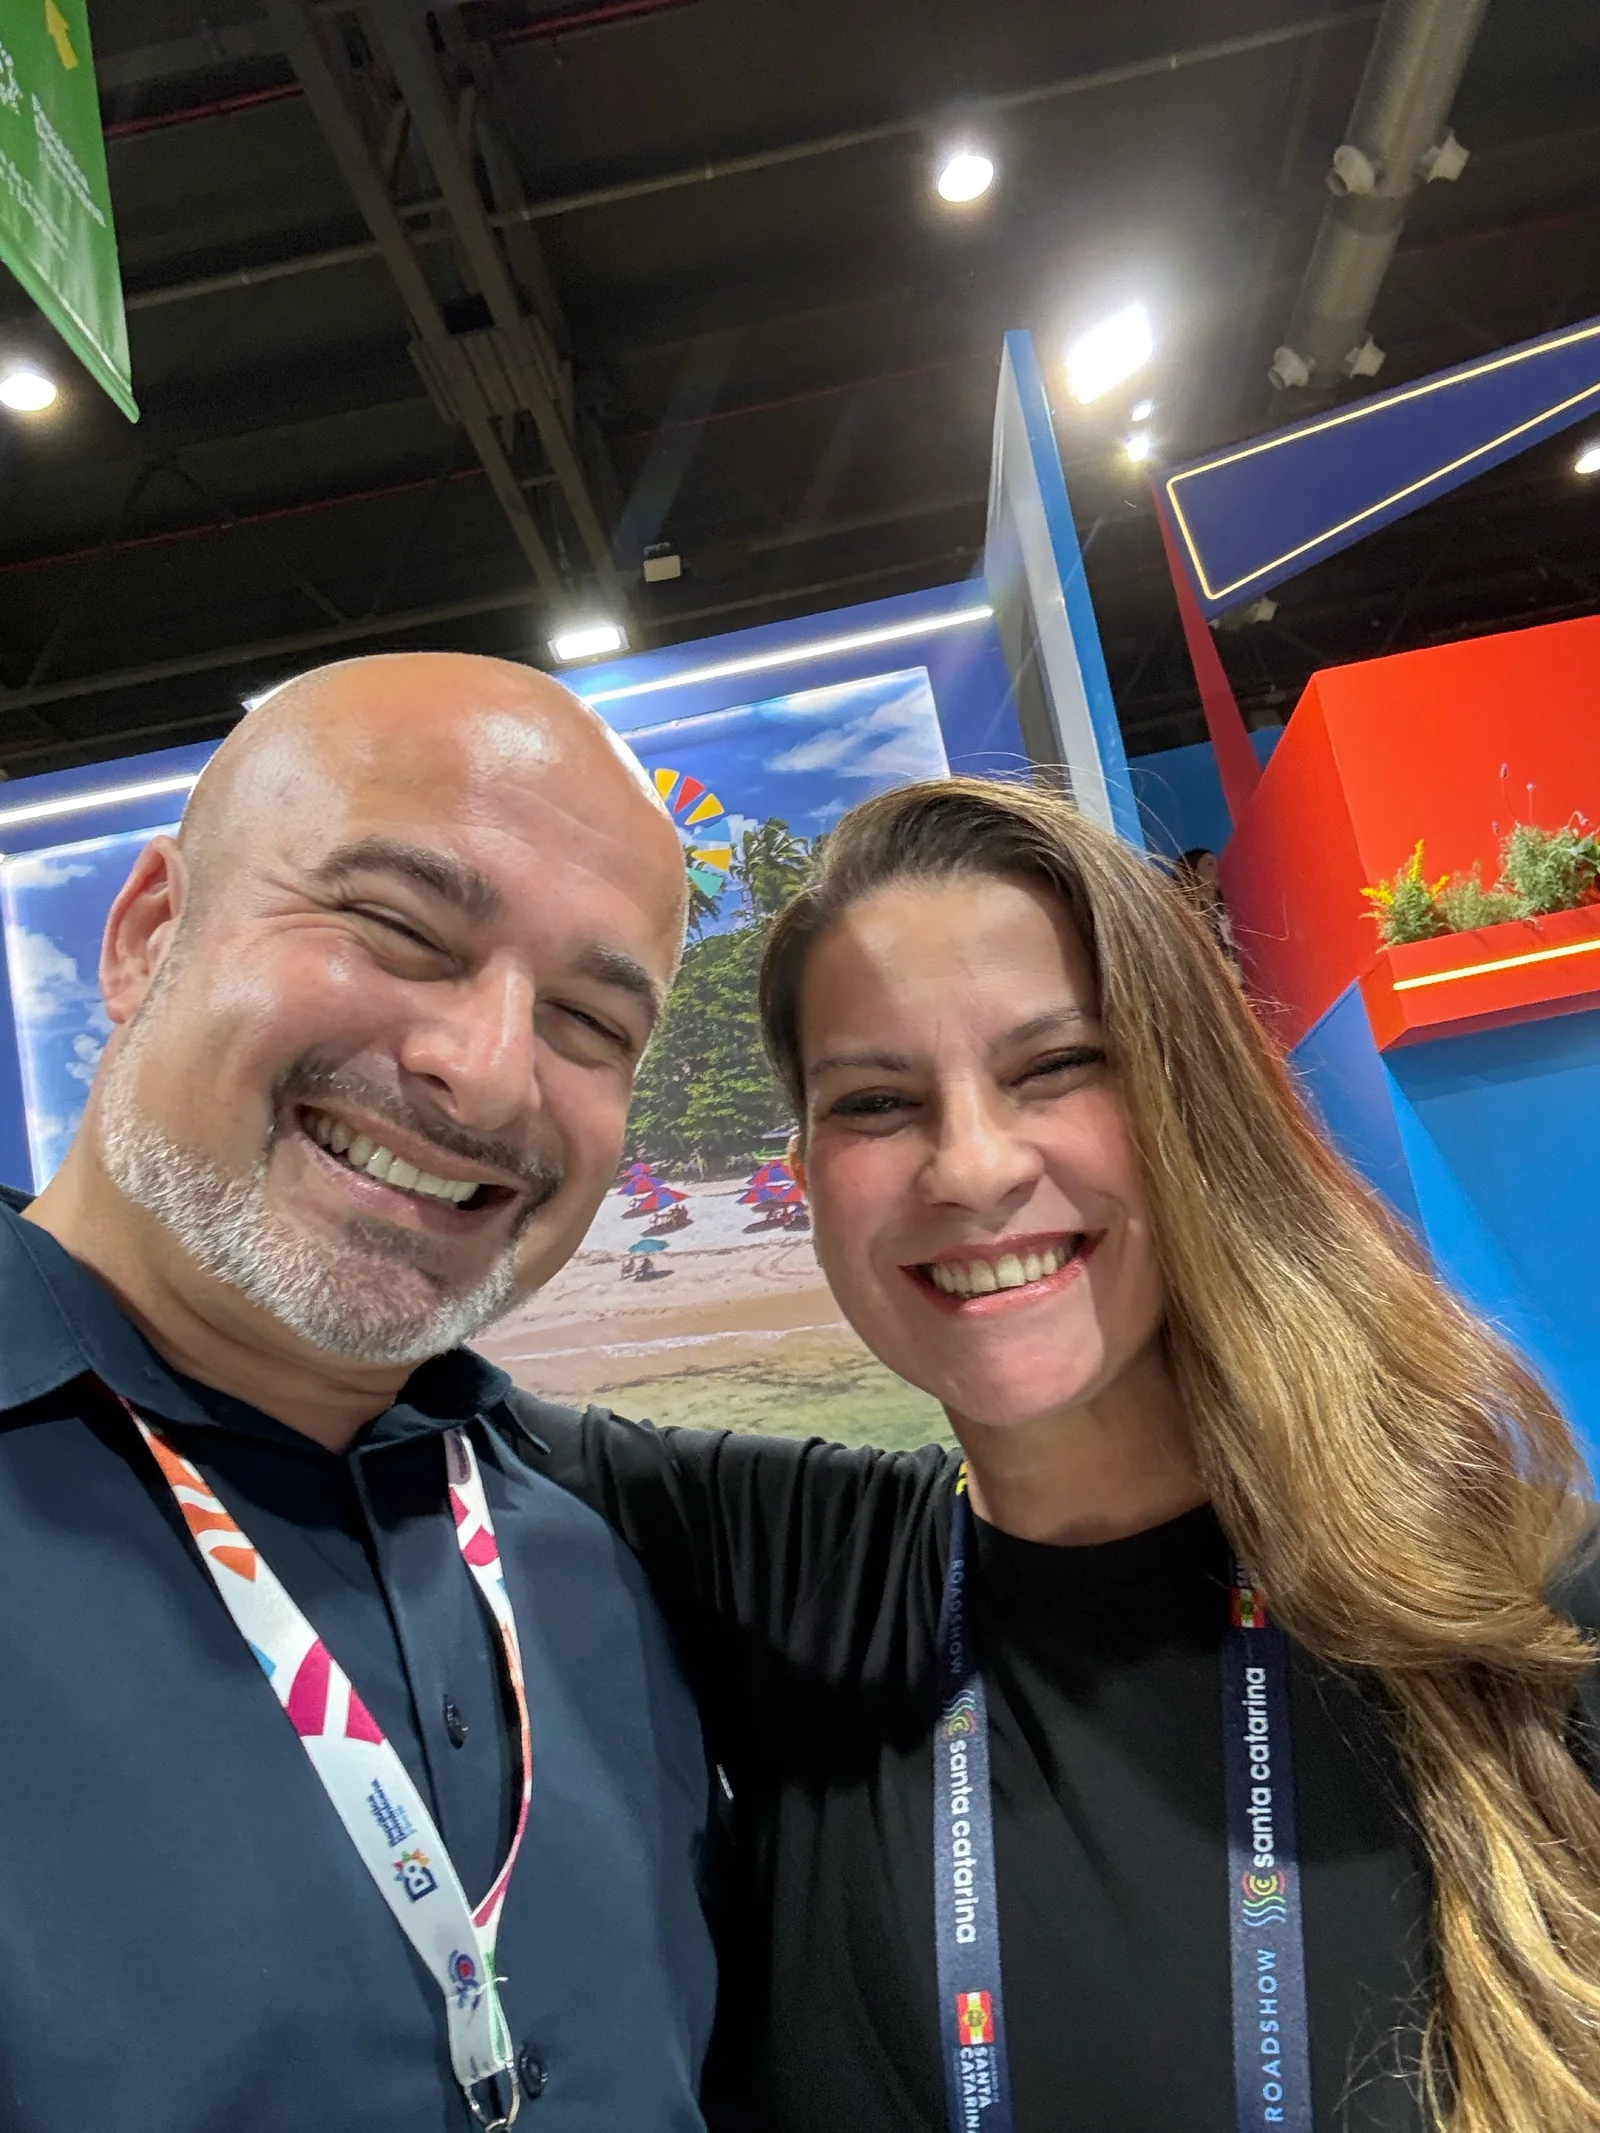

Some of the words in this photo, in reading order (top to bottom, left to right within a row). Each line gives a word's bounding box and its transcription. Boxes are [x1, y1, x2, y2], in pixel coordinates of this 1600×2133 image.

[1242, 1667, 1270, 1781] catarina
[950, 1739, 974, 1815] santa
[1246, 1787, 1275, 1868] santa
[952, 1820, 979, 1944] catarina
[974, 2047, 992, 2108] SANTA
[1257, 1949, 1284, 2123] ROADSHOW
[960, 2047, 980, 2133] CATARIN
